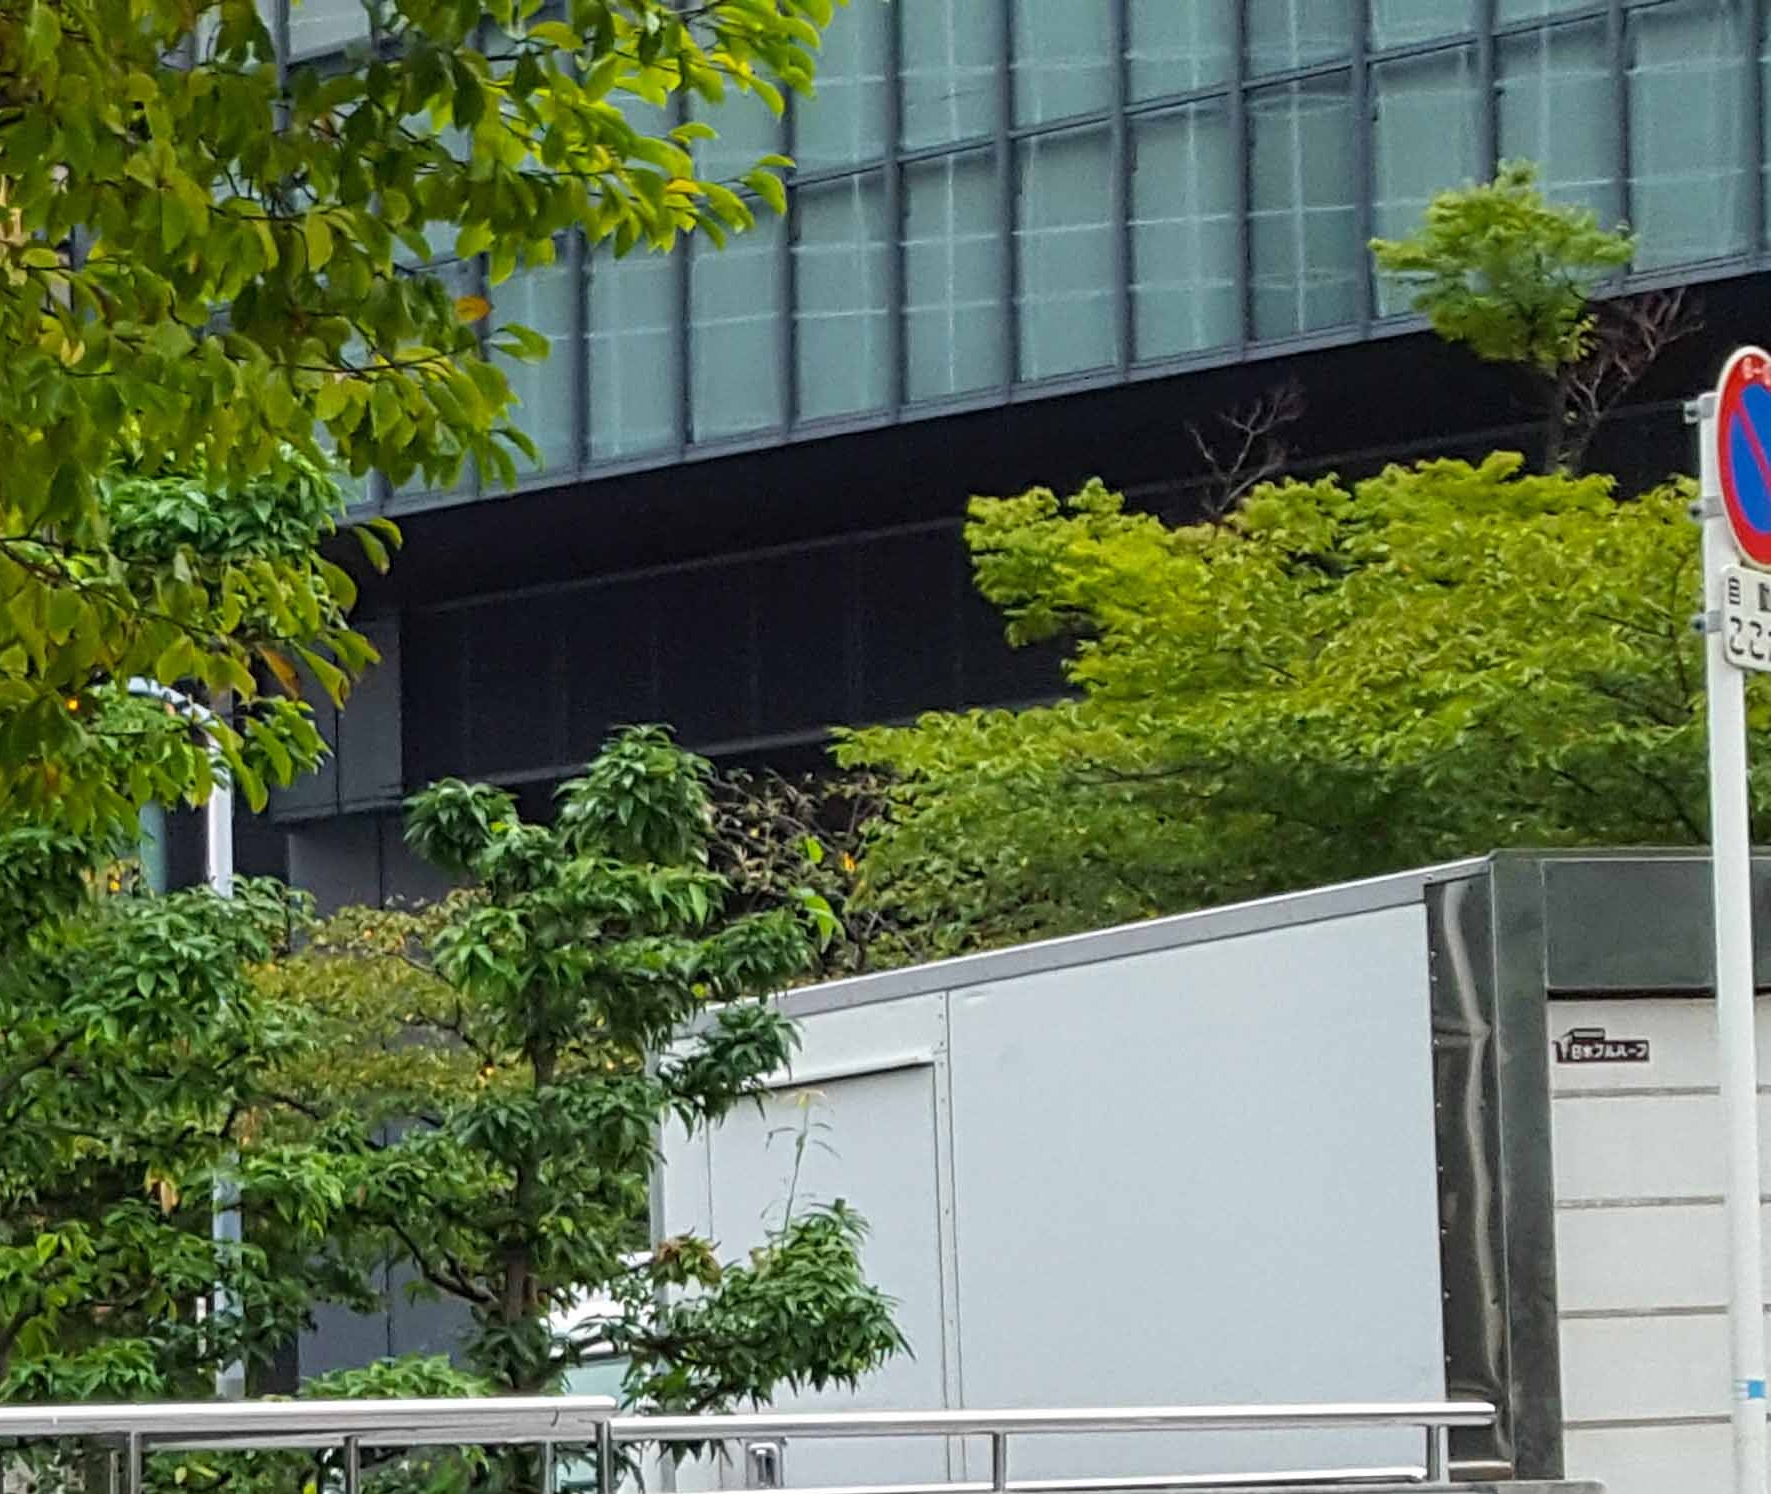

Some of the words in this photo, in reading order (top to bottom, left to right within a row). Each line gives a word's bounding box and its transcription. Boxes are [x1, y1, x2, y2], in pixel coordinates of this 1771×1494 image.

[1730, 616, 1771, 661] ここ
[1571, 1043, 1647, 1060] 日本フルハーフ
